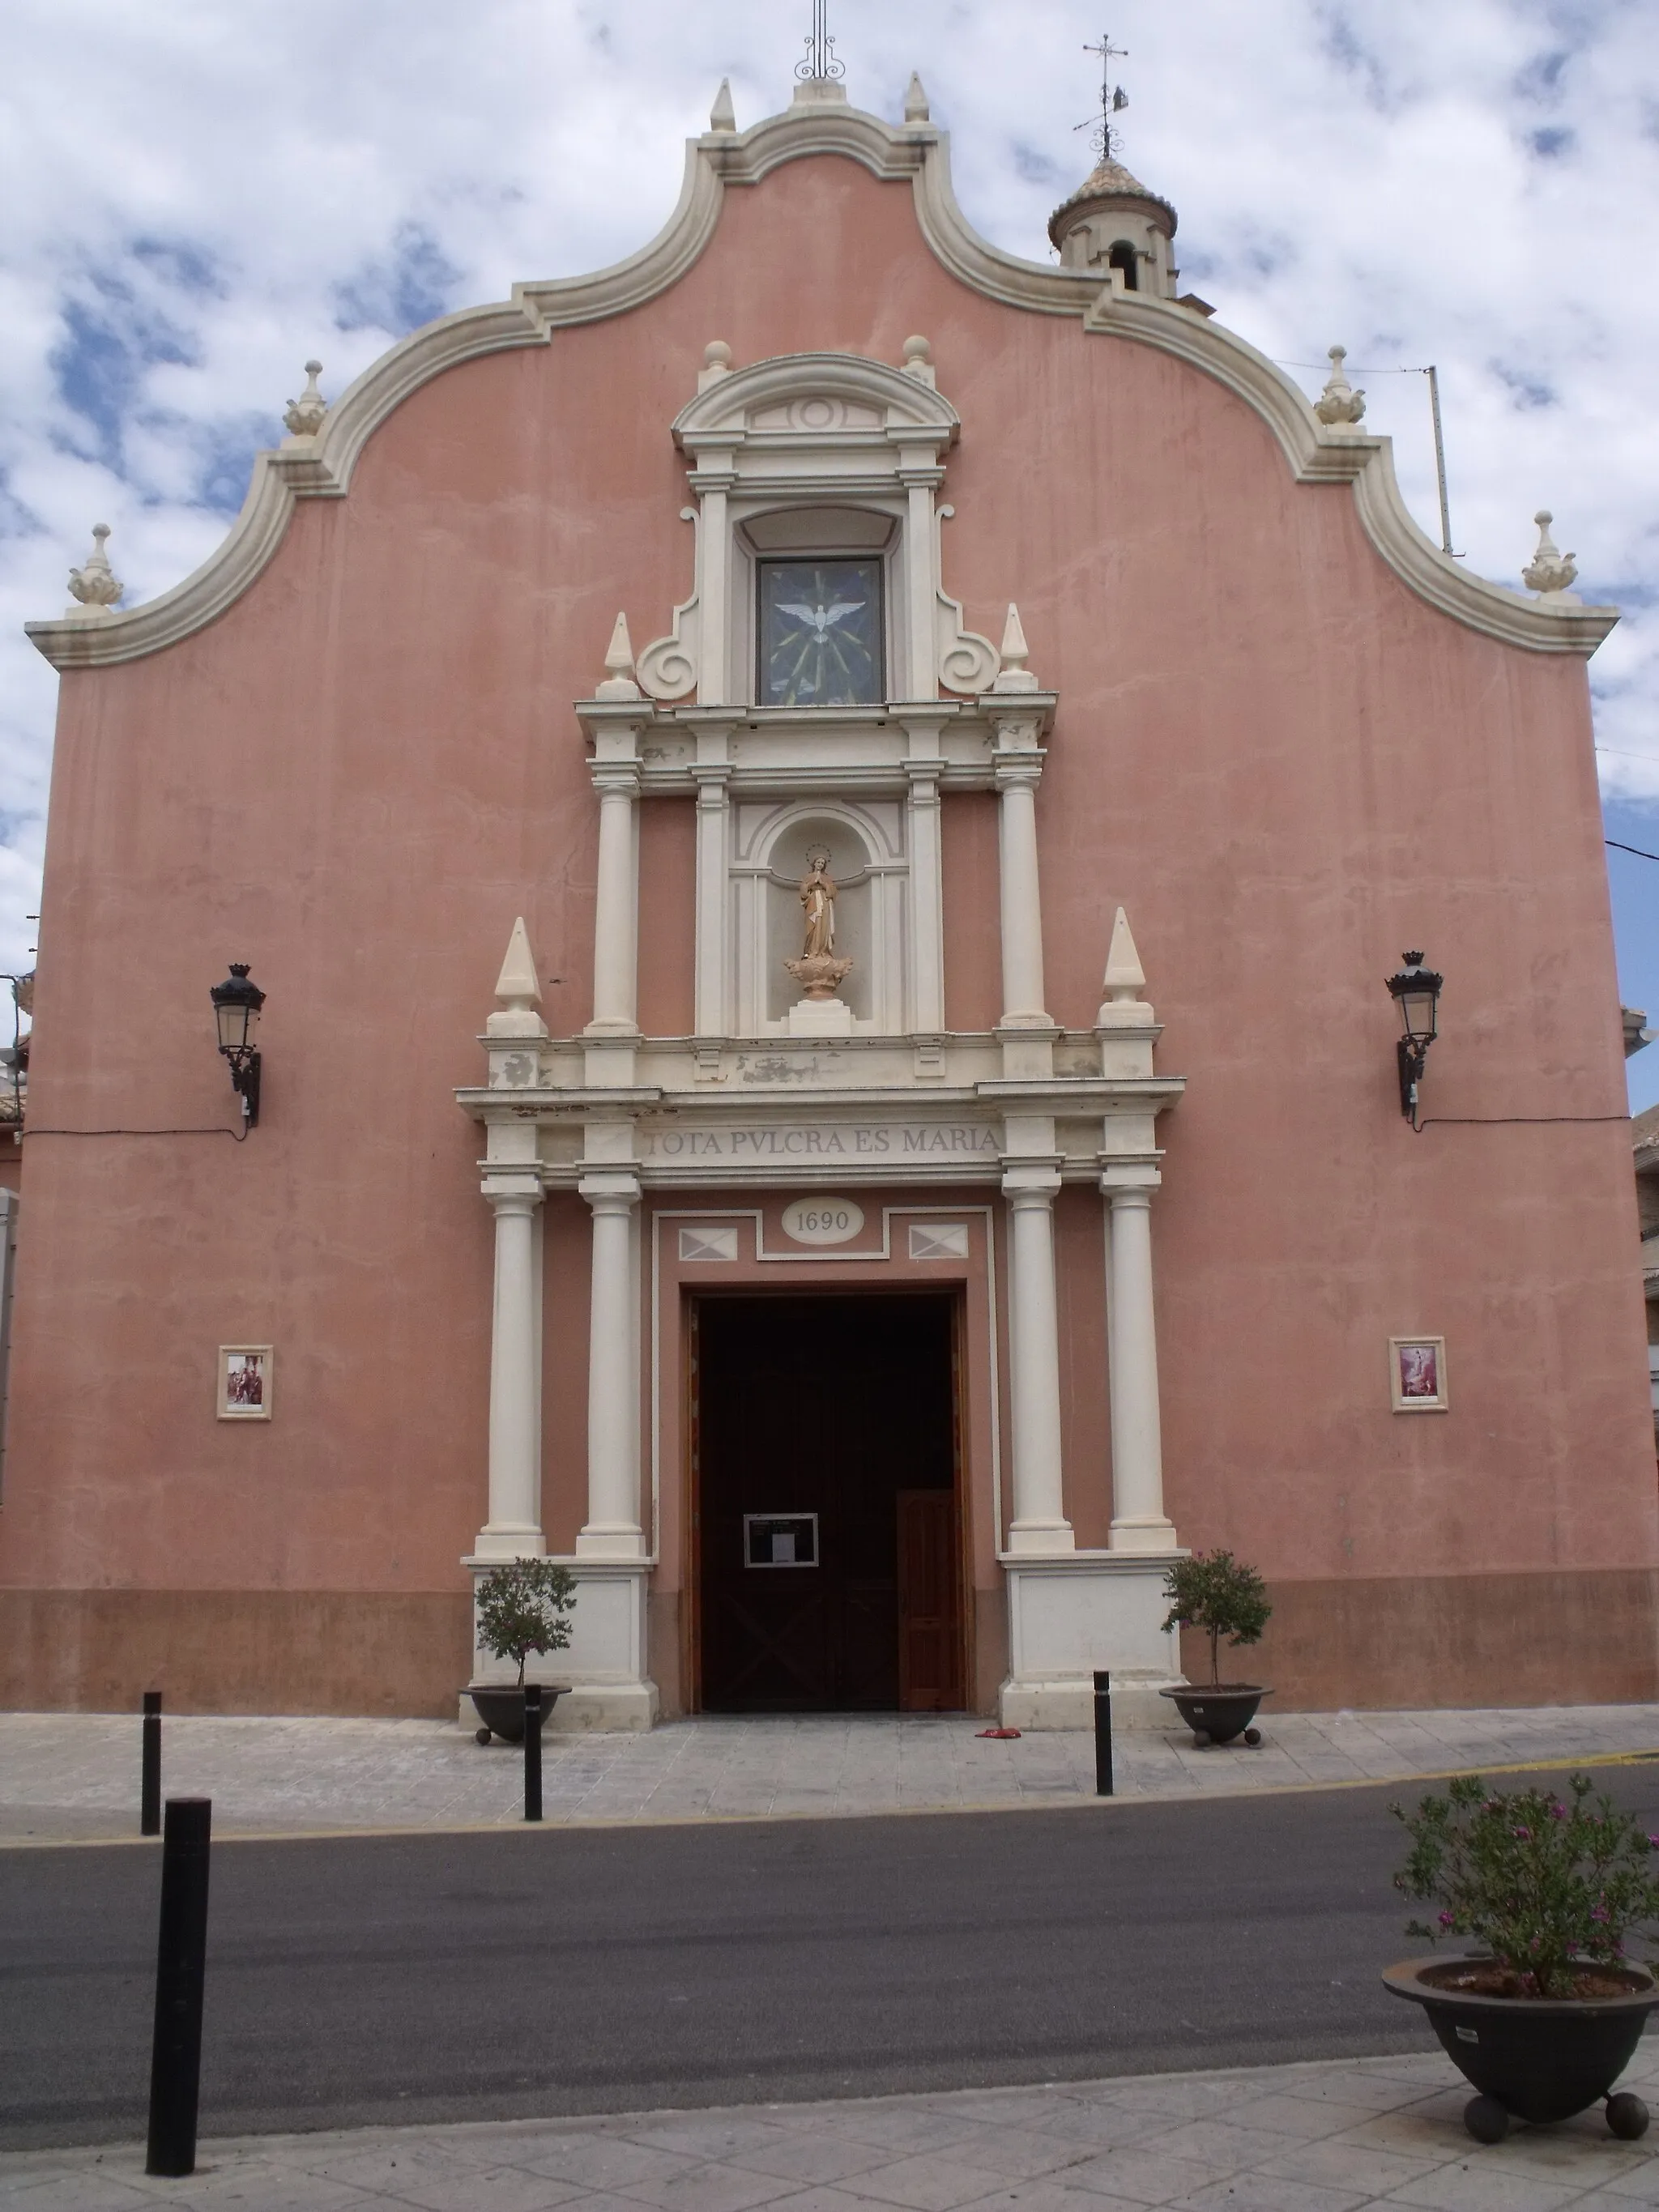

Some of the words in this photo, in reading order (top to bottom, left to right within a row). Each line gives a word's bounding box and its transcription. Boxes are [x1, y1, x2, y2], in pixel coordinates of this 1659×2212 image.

[642, 1132, 723, 1155] TOTA
[731, 1129, 846, 1154] PVLCRA
[855, 1128, 890, 1153] ES
[902, 1127, 1000, 1152] MARIA
[797, 1211, 849, 1231] 1690
